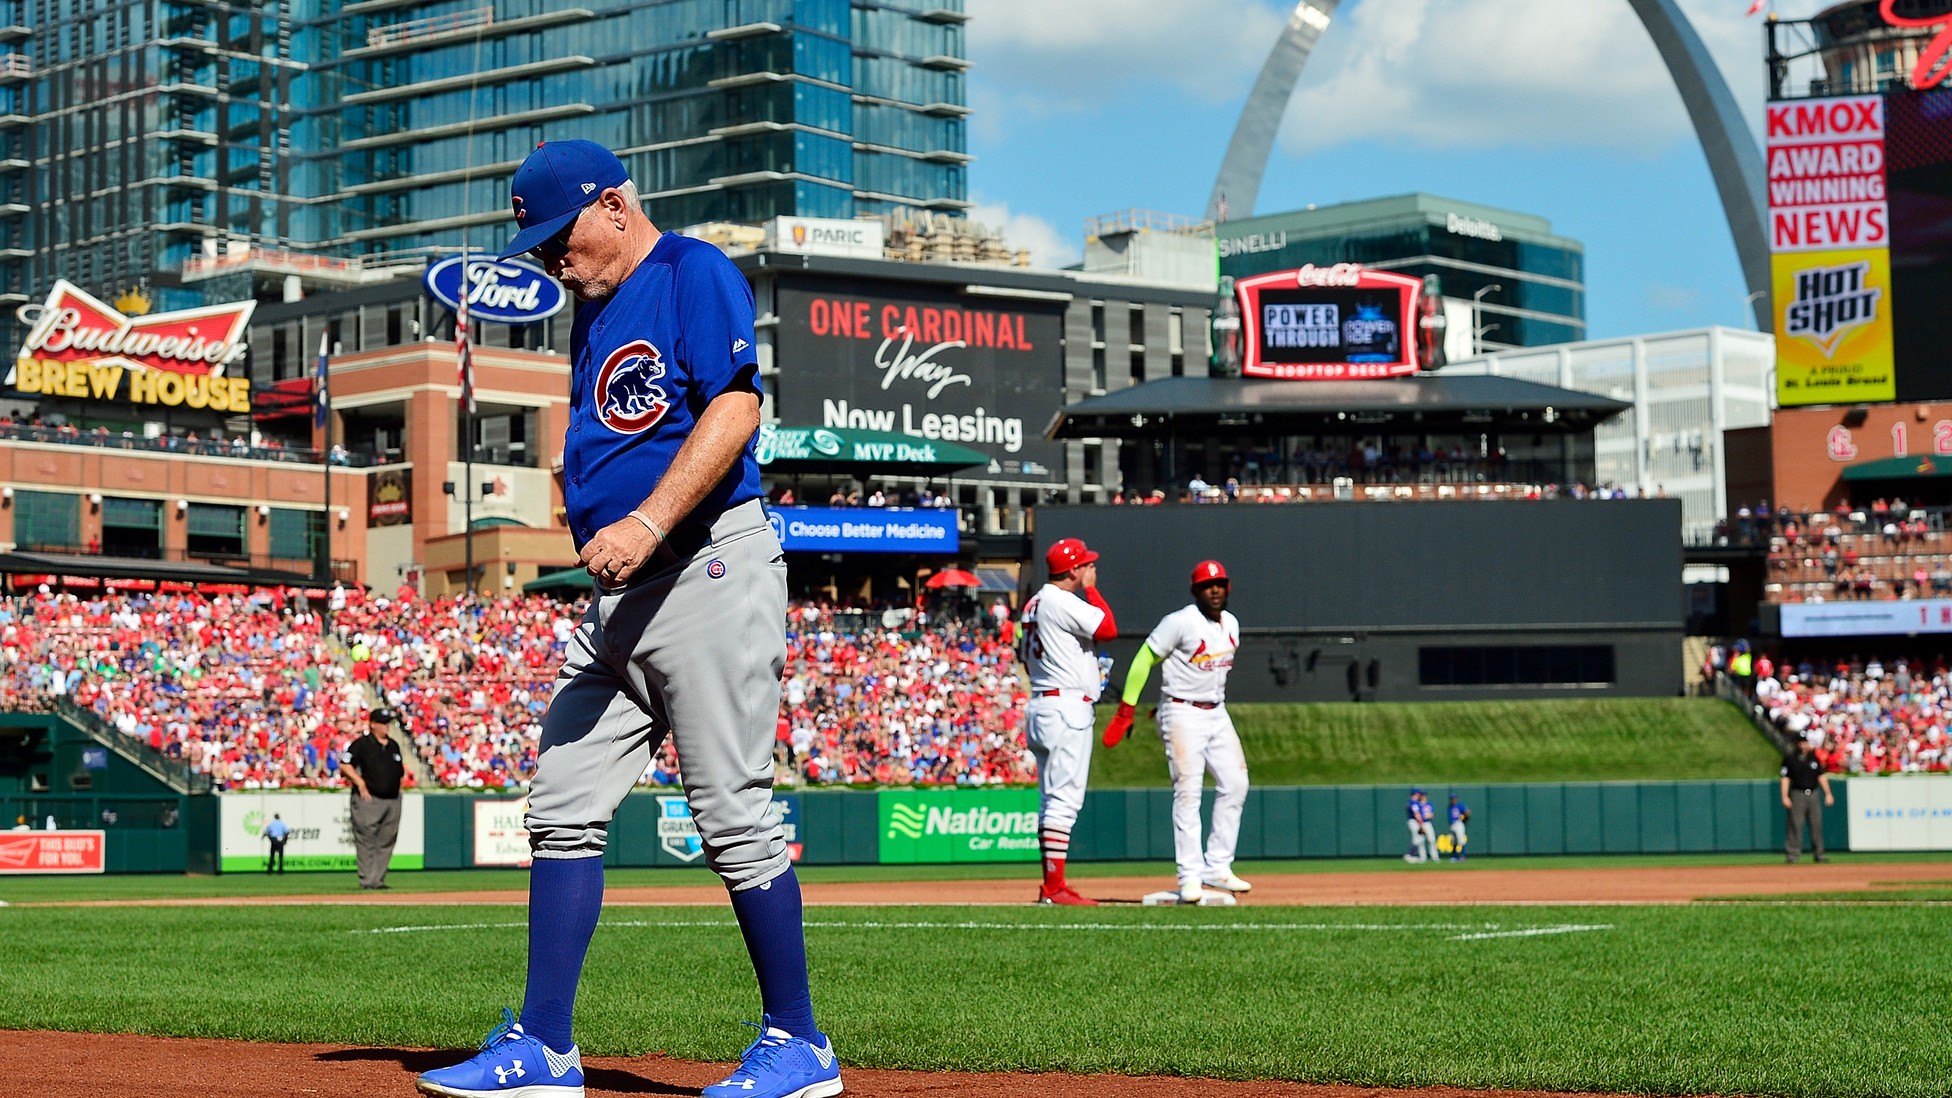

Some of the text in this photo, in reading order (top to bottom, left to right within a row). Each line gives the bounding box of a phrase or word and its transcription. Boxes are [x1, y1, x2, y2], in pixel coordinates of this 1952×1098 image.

[1768, 101, 1880, 137] KMOX
[1770, 144, 1883, 178] AWARD
[1771, 176, 1883, 204] WINNING
[813, 228, 863, 243] PARIC
[1775, 208, 1884, 246] NEWS
[466, 263, 541, 312] Ford
[1800, 266, 1867, 300] HOT
[810, 298, 1033, 350] ONE CARDINAL
[1268, 308, 1336, 326] POWER
[1790, 294, 1877, 333] SHOT
[16, 304, 248, 364] Budweiser
[1267, 328, 1339, 348] THROUGH
[874, 325, 972, 400] Way
[1275, 364, 1388, 377] ROOFTOP DECK
[16, 357, 251, 413] BREW HOUSE
[823, 398, 1023, 453] Now Leasing
[853, 443, 936, 462] MVP Deck
[789, 521, 945, 540] Choose Better Medicine
[493, 816, 522, 828] HAL
[925, 806, 1039, 835] Nationa
[39, 837, 95, 851] THIS BUD'S
[969, 837, 1040, 850] Car Renta
[39, 852, 84, 865] FOR YOU.
